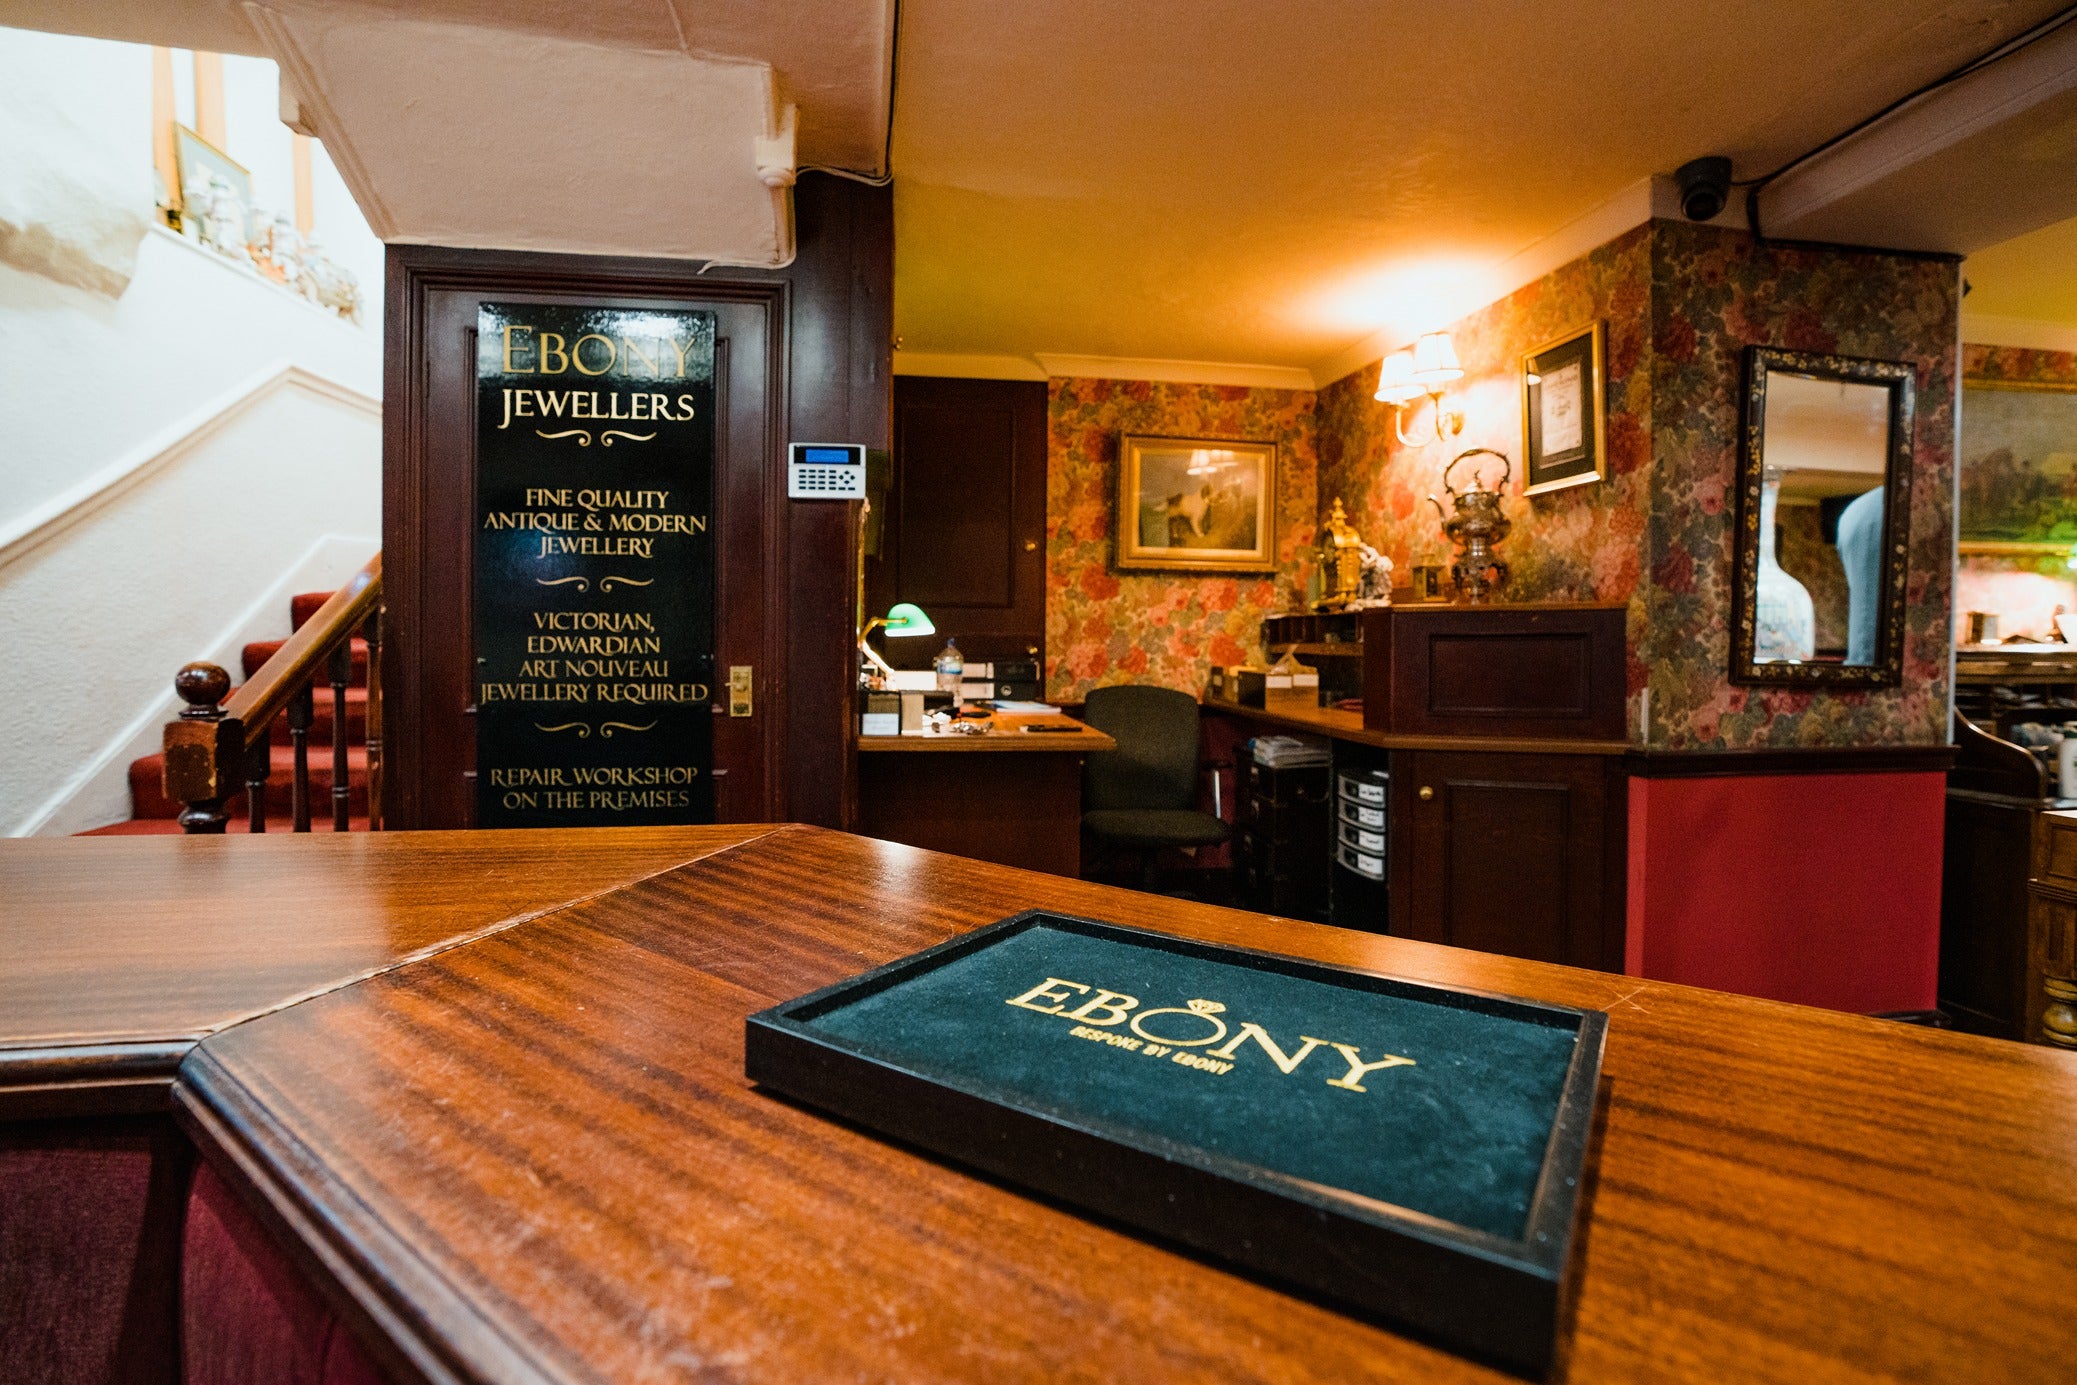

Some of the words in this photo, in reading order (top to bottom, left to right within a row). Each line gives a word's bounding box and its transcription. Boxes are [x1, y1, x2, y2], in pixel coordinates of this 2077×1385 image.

[502, 325, 696, 378] EBONY
[497, 388, 695, 429] JEWELLERS
[526, 488, 572, 507] FINE
[577, 489, 669, 512] QUALITY
[483, 512, 579, 534] ANTIQUE
[583, 513, 603, 531] &
[609, 513, 707, 535] MODERN
[535, 537, 654, 559] JEWELLERY
[534, 612, 655, 633] VICTORIAN,
[527, 636, 661, 656] EDWARDIAN
[519, 660, 560, 679] ART
[565, 660, 668, 678] NOUVEAU
[481, 683, 591, 704] JEWELLERY
[597, 684, 708, 704] REQUIRED
[490, 768, 573, 787] REPAIR
[573, 767, 698, 787] WORKSHOP
[503, 792, 538, 810] ON
[543, 791, 584, 809] THE
[590, 790, 690, 811] PREMISES
[1005, 977, 1416, 1092] EBONY
[1069, 1025, 1144, 1051] BESPOKE
[1142, 1043, 1172, 1058] BY
[1171, 1051, 1234, 1076] EBONY
